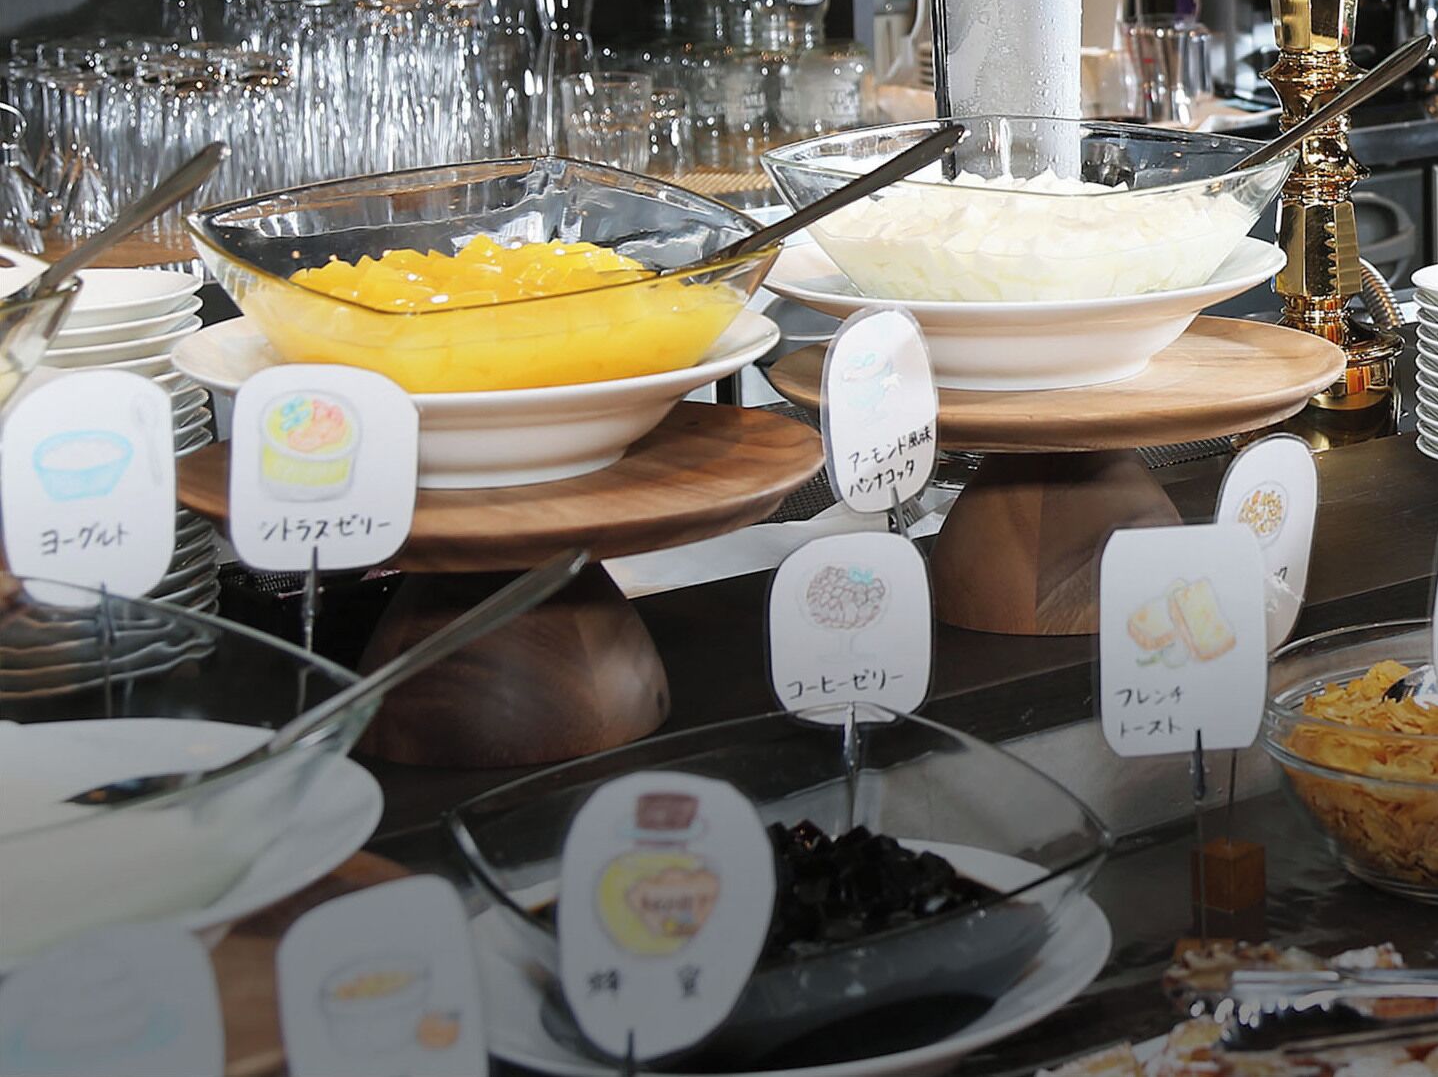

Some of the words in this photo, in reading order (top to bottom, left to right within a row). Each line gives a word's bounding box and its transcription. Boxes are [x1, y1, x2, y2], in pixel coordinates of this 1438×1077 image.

[848, 425, 934, 474] アーモンド風味
[849, 459, 916, 498] パンナコッタ
[40, 521, 130, 555] ヨーグルト
[260, 513, 392, 542] シトラスゼリー
[786, 669, 904, 700] コーヒーゼリー
[1114, 687, 1185, 707] フレンチ
[1119, 716, 1183, 739] トースト
